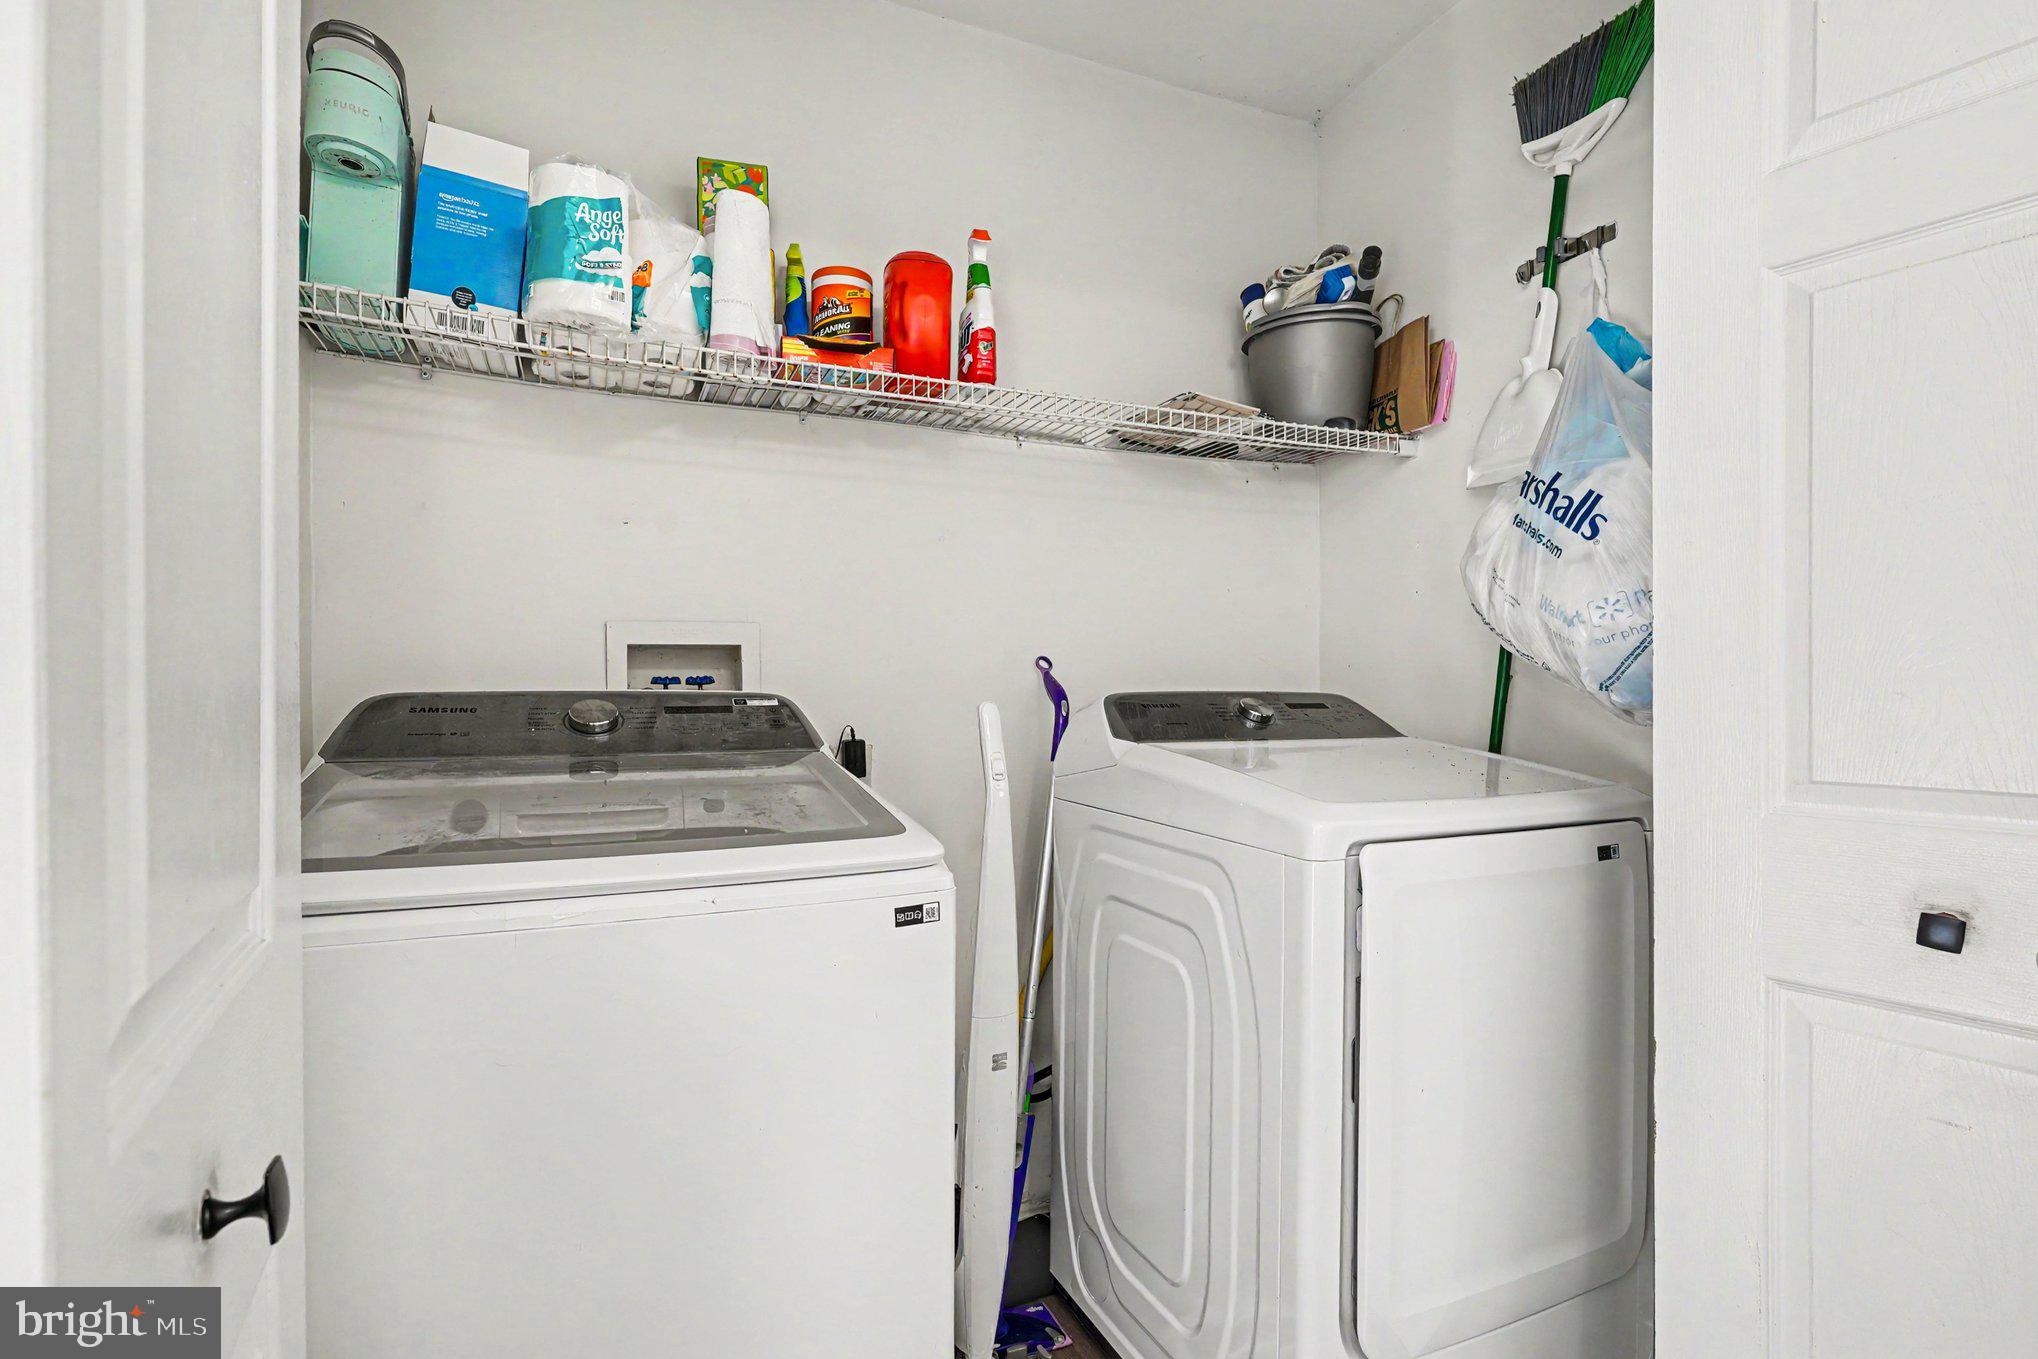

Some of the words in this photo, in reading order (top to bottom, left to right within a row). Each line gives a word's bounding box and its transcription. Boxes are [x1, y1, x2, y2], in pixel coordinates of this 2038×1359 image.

[575, 202, 623, 228] Ange
[1519, 470, 1608, 541] arshalls
[1594, 633, 1617, 646] our
[1620, 621, 1654, 642] pho
[408, 706, 478, 714] SAMSUNG
